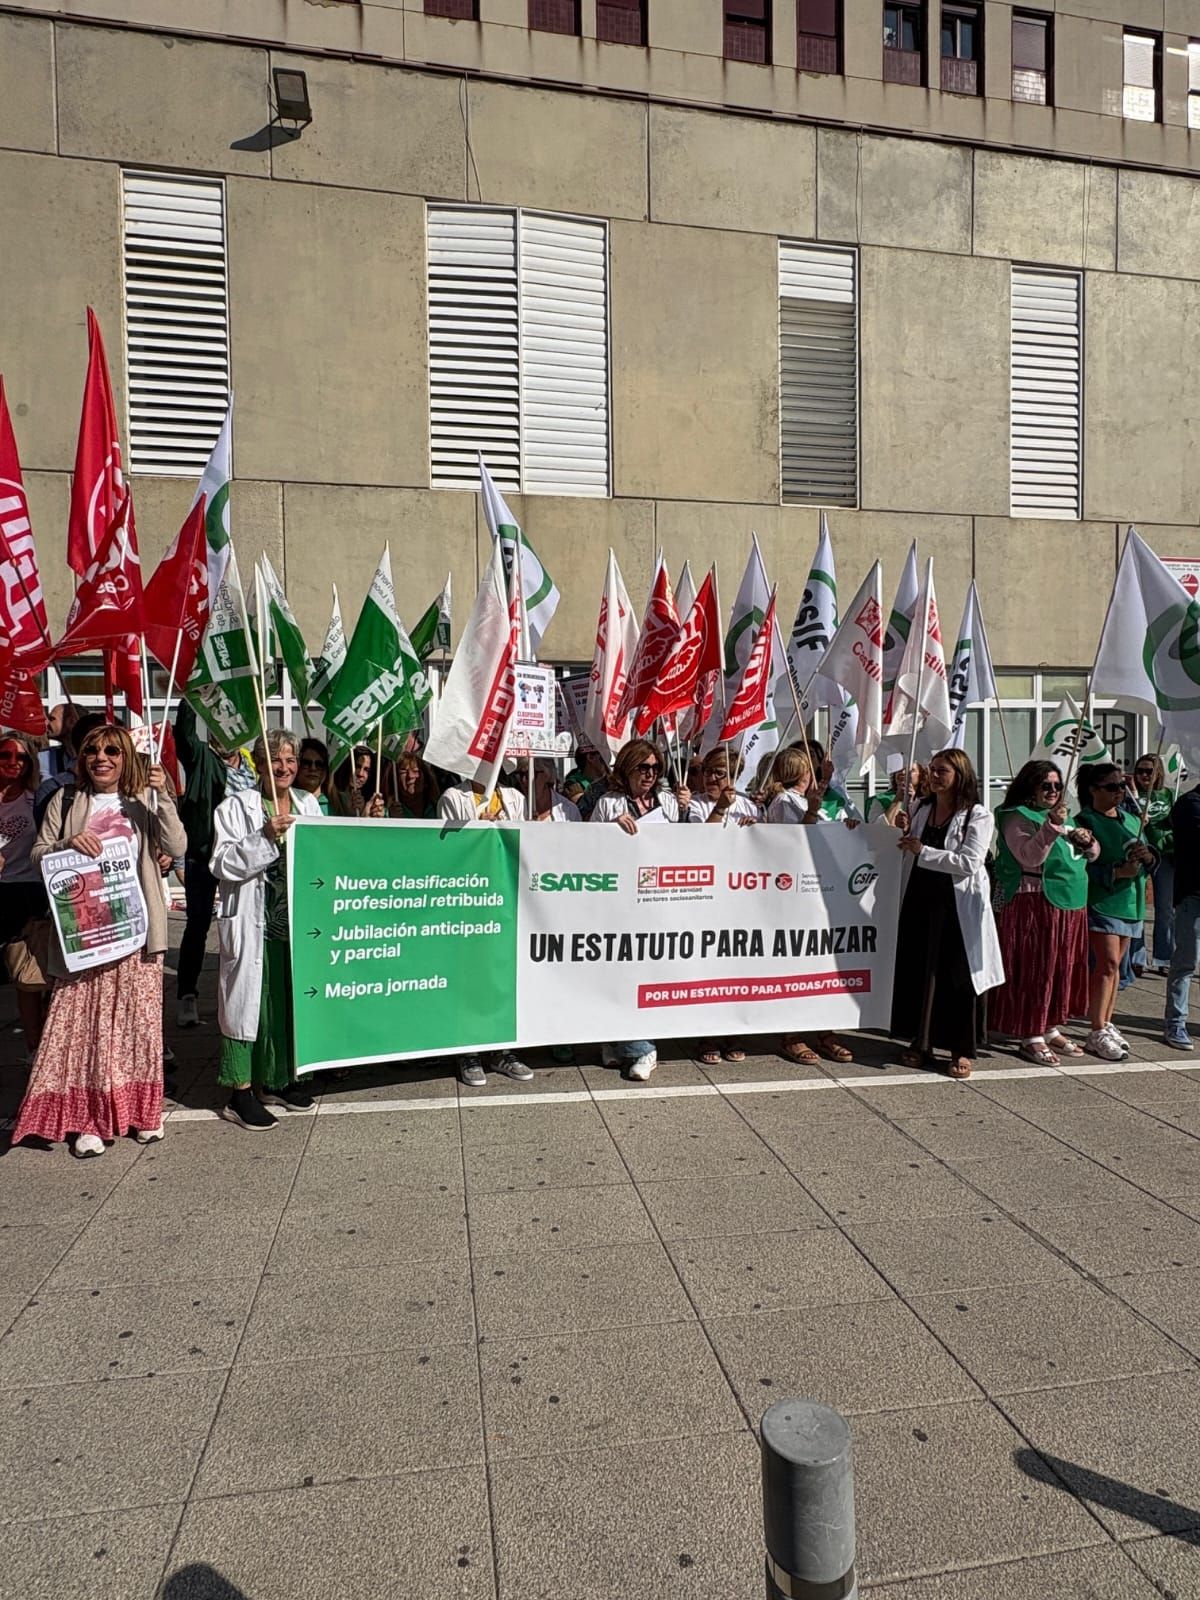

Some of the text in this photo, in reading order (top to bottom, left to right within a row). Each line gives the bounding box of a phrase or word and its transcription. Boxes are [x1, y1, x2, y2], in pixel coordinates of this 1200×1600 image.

[98, 858, 131, 875] 16 Sep
[662, 869, 711, 884] CCOO
[335, 873, 489, 891] Nueva clasificación
[540, 872, 619, 892] SATSE
[728, 872, 772, 891] UGT
[333, 892, 503, 914] profesional retribuida
[331, 920, 501, 941] Jubilación anticipada
[330, 943, 401, 965] y parcial
[529, 925, 878, 963] UN ESTATUTO PARA AVANZAR
[325, 975, 448, 1000] Mejora jornada
[645, 977, 864, 1002] POR UN ESTATUTO PARA TODAS/TODOS
